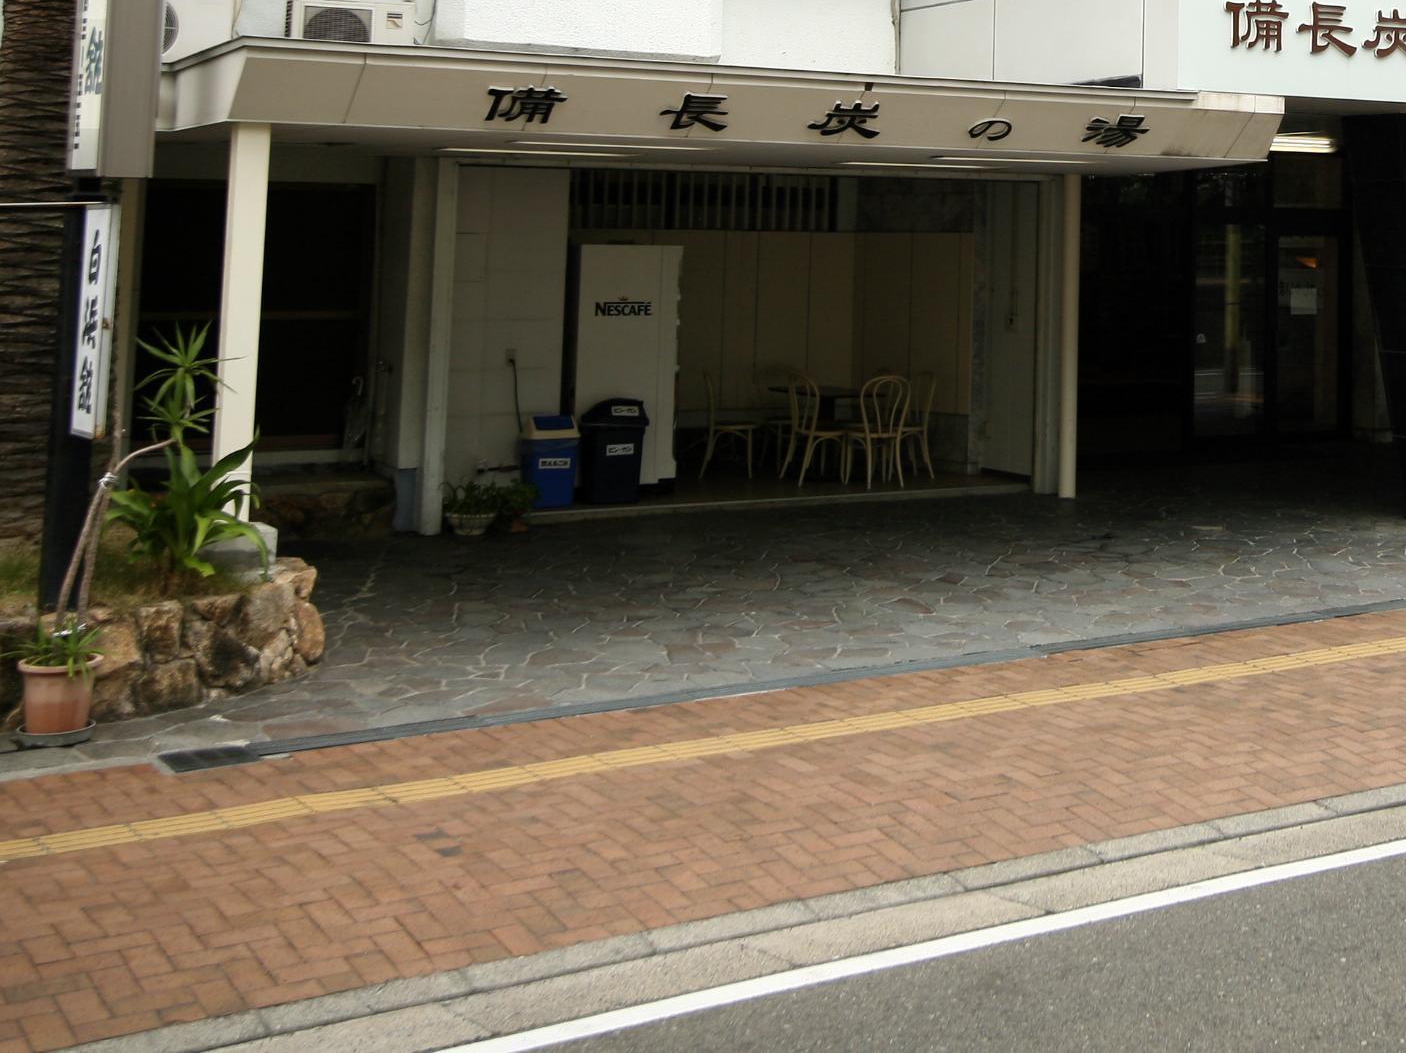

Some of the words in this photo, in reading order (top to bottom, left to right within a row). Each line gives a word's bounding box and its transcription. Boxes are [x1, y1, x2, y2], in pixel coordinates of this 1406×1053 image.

[484, 85, 1150, 148] 備長炭の湯
